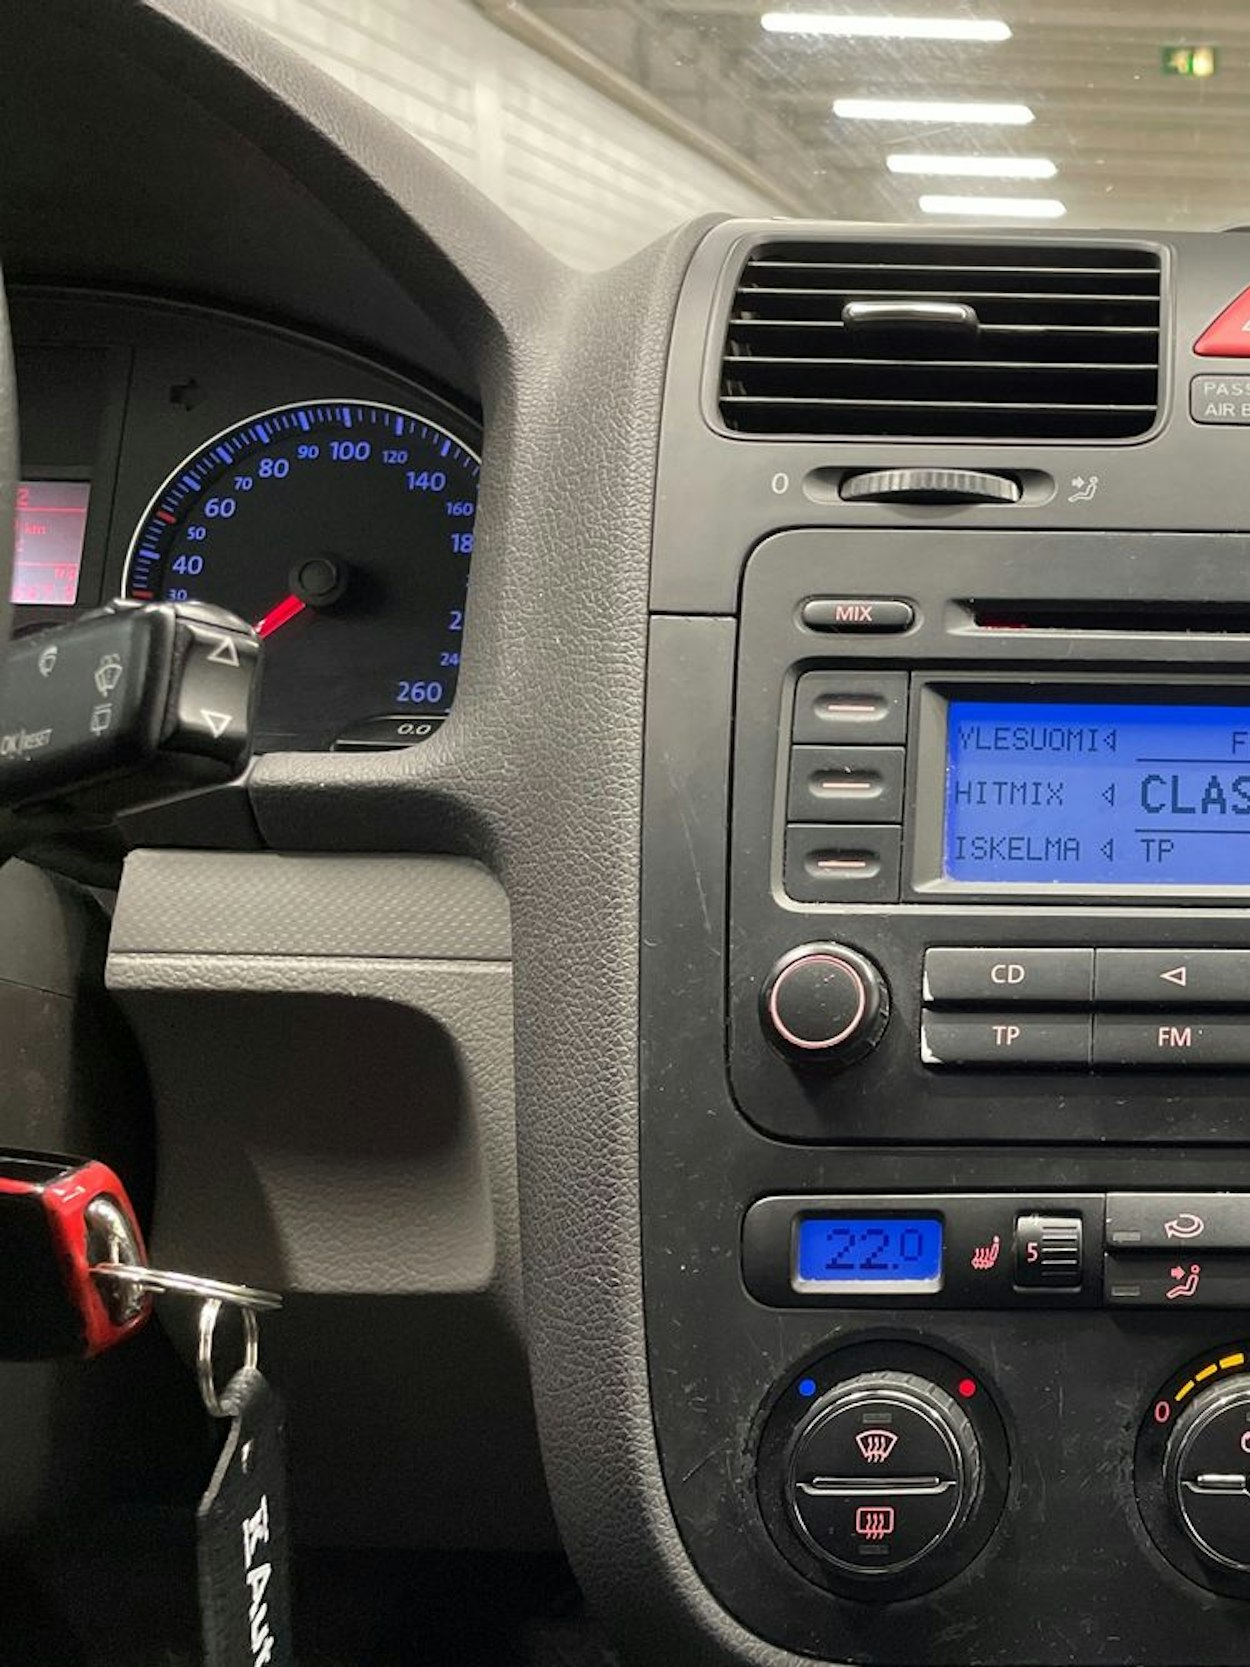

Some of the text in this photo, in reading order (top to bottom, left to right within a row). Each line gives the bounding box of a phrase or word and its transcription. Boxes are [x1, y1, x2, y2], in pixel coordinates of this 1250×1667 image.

[1204, 403, 1236, 417] AIR
[297, 444, 320, 459] 90
[329, 440, 371, 461] 100
[382, 450, 408, 464] 120
[258, 457, 290, 478] 80
[233, 476, 253, 491] 70
[405, 470, 446, 492] 140
[204, 497, 236, 518] 60
[446, 501, 474, 516] 160
[186, 526, 207, 540] 50
[450, 532, 474, 554] 18
[172, 555, 203, 575] 40
[168, 589, 188, 601] 30
[835, 606, 873, 622] MIX
[440, 652, 461, 666] 24
[396, 681, 443, 703] 260
[958, 726, 1099, 752] YLESUOMI
[954, 780, 1064, 806] HITMIX
[955, 836, 1080, 861] ISKELMA
[1140, 838, 1174, 863] TP
[990, 964, 1025, 984] CD
[992, 1025, 1021, 1046] TP
[1158, 1026, 1192, 1047] FM
[1026, 1242, 1039, 1263] 5
